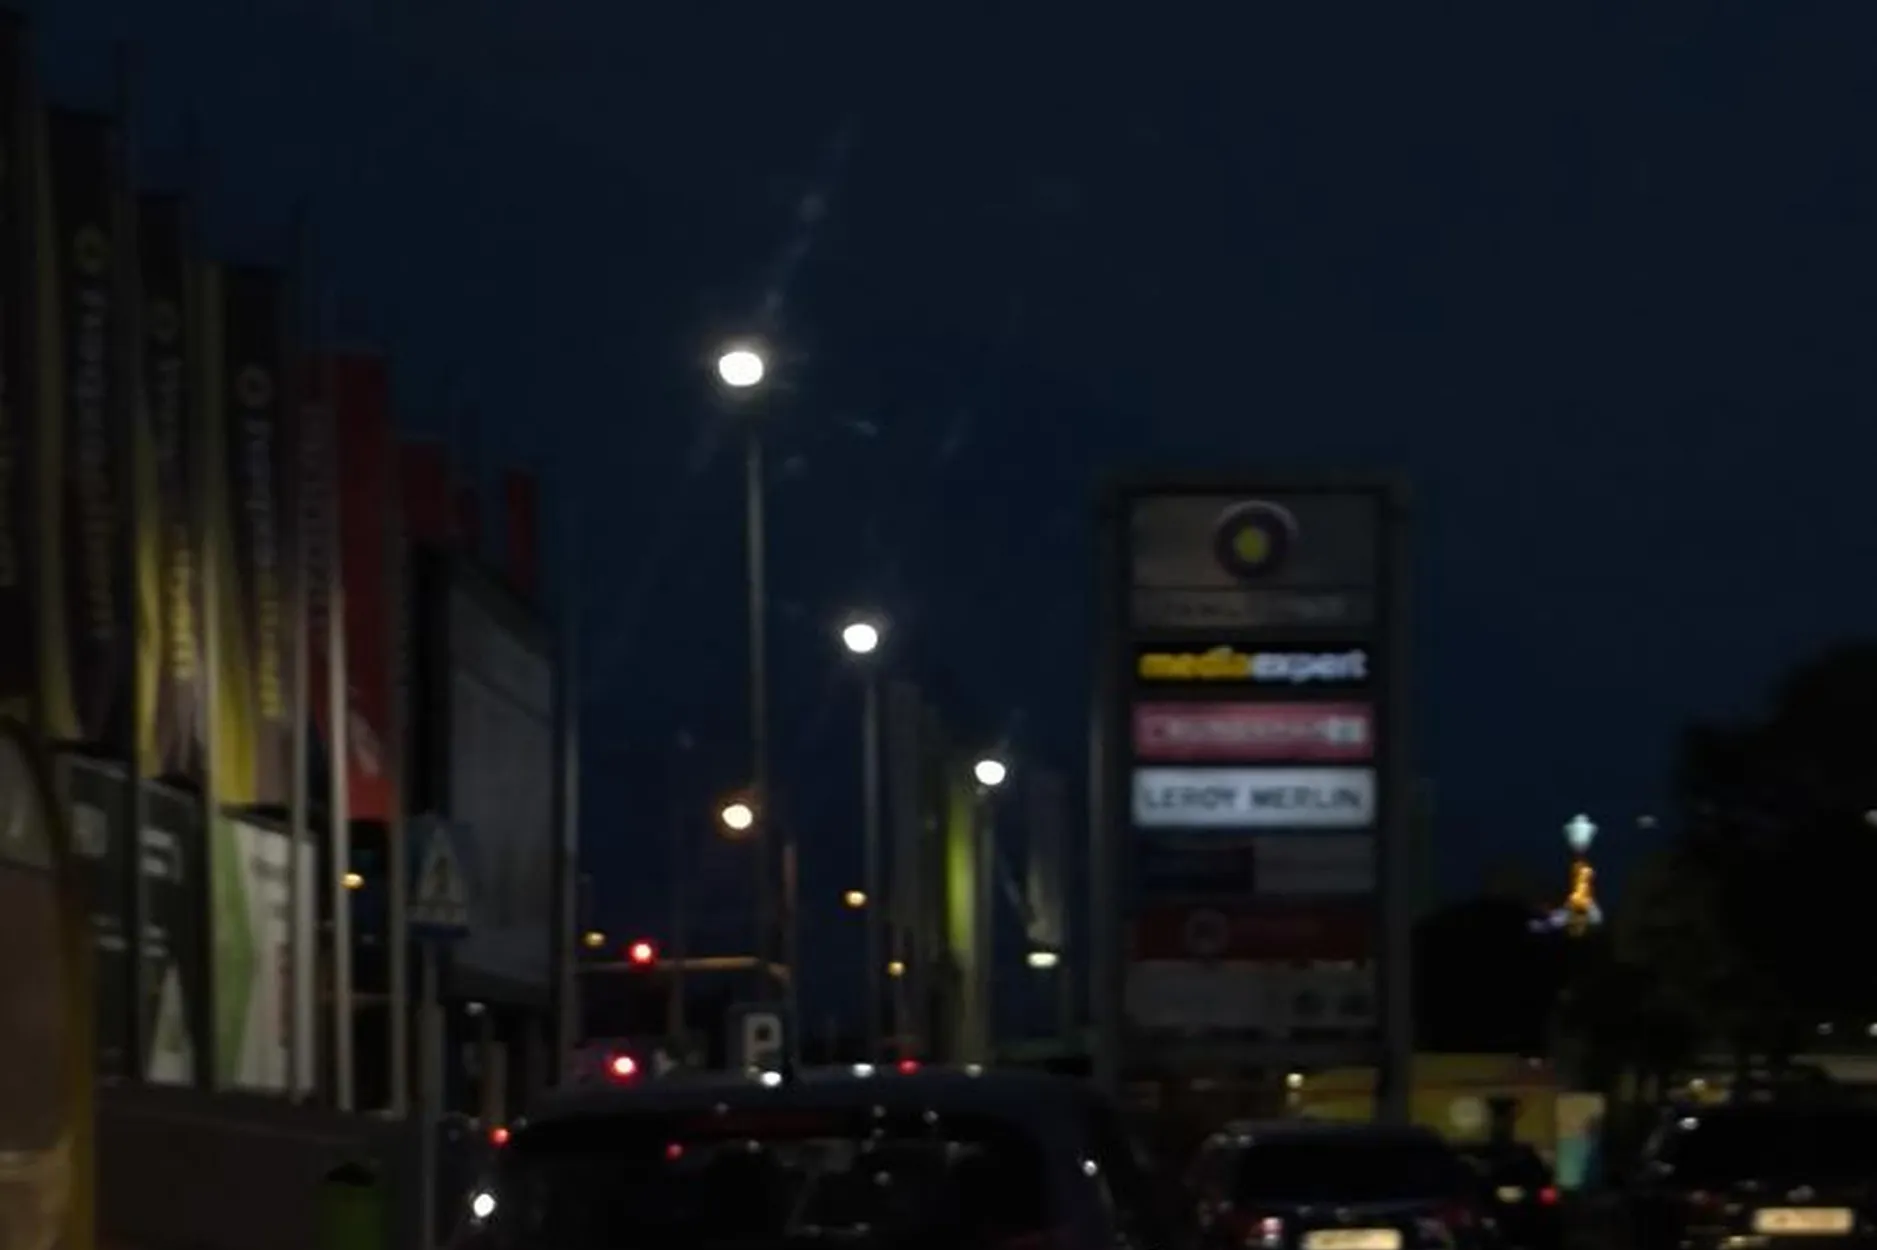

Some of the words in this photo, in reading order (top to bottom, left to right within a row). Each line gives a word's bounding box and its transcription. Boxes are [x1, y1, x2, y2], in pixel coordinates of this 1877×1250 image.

[1146, 785, 1237, 810] LEROY
[1251, 784, 1362, 810] MERLIN
[743, 1013, 784, 1063] P
